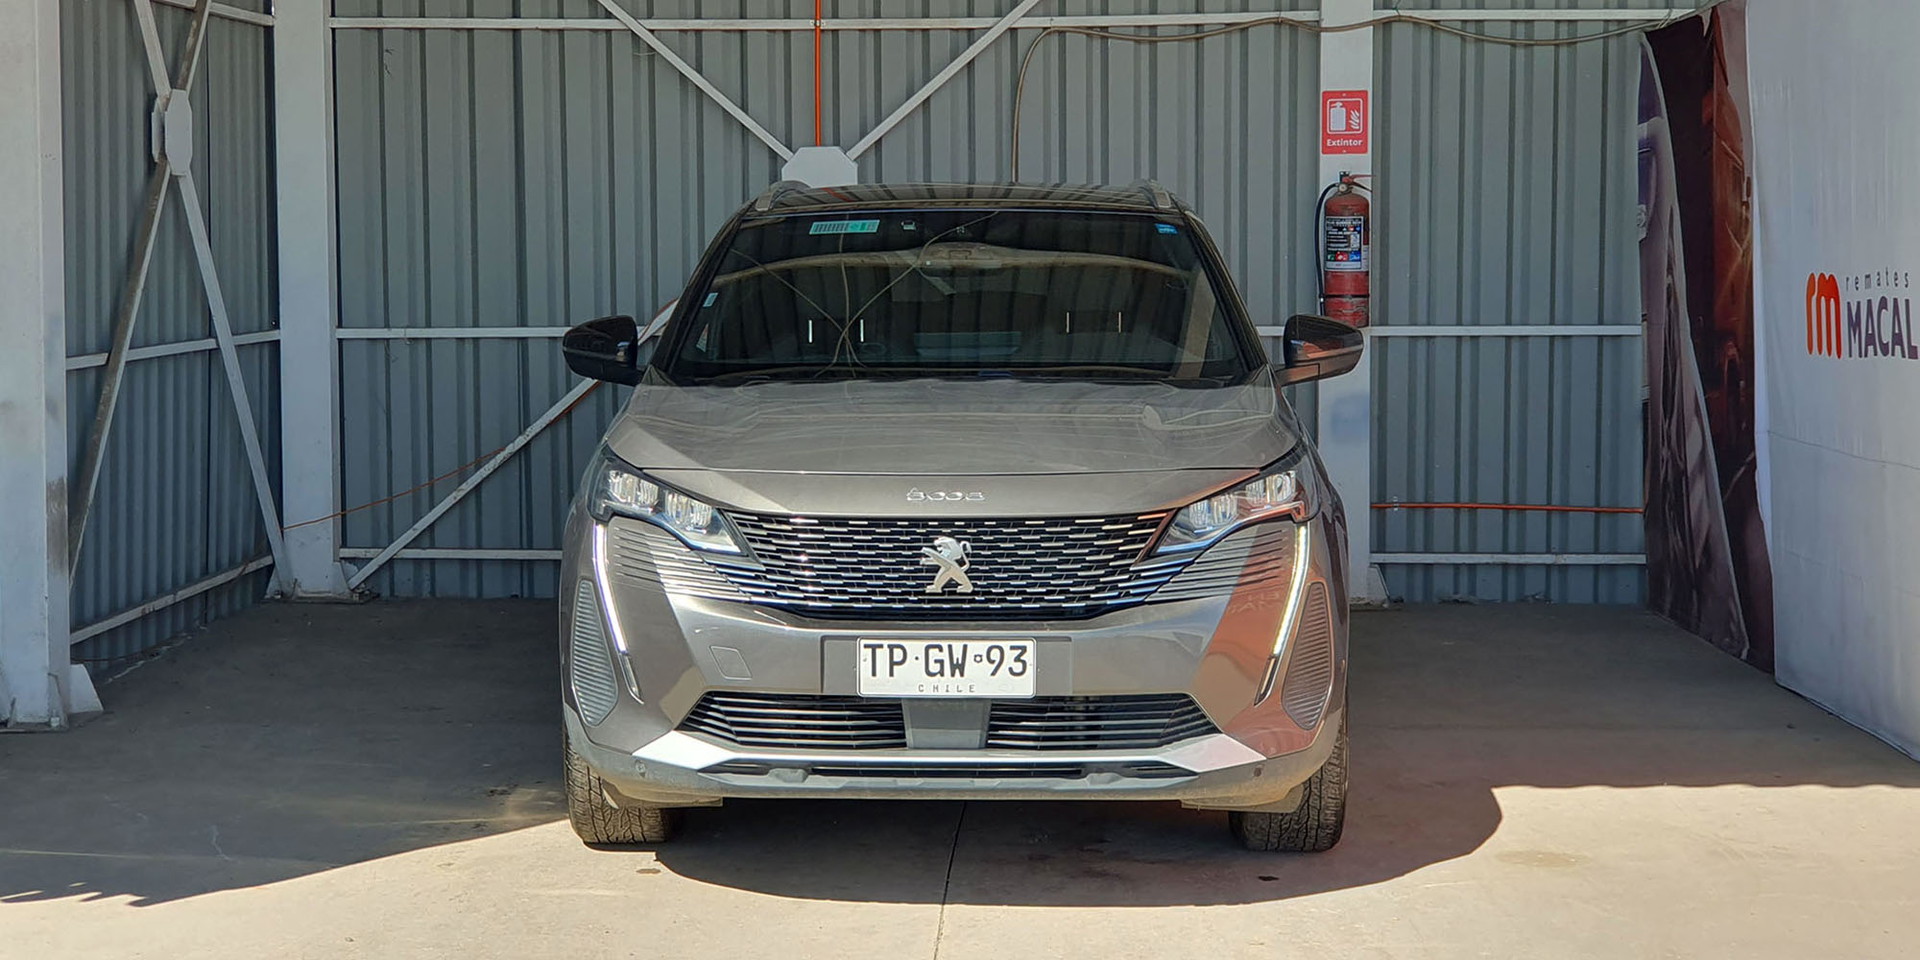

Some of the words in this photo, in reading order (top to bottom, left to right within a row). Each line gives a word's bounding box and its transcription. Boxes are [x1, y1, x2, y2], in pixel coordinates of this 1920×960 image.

[1327, 138, 1363, 146] Extintor
[1846, 266, 1909, 291] remates
[1846, 296, 1919, 360] MACAL
[918, 684, 976, 692] CHILE
